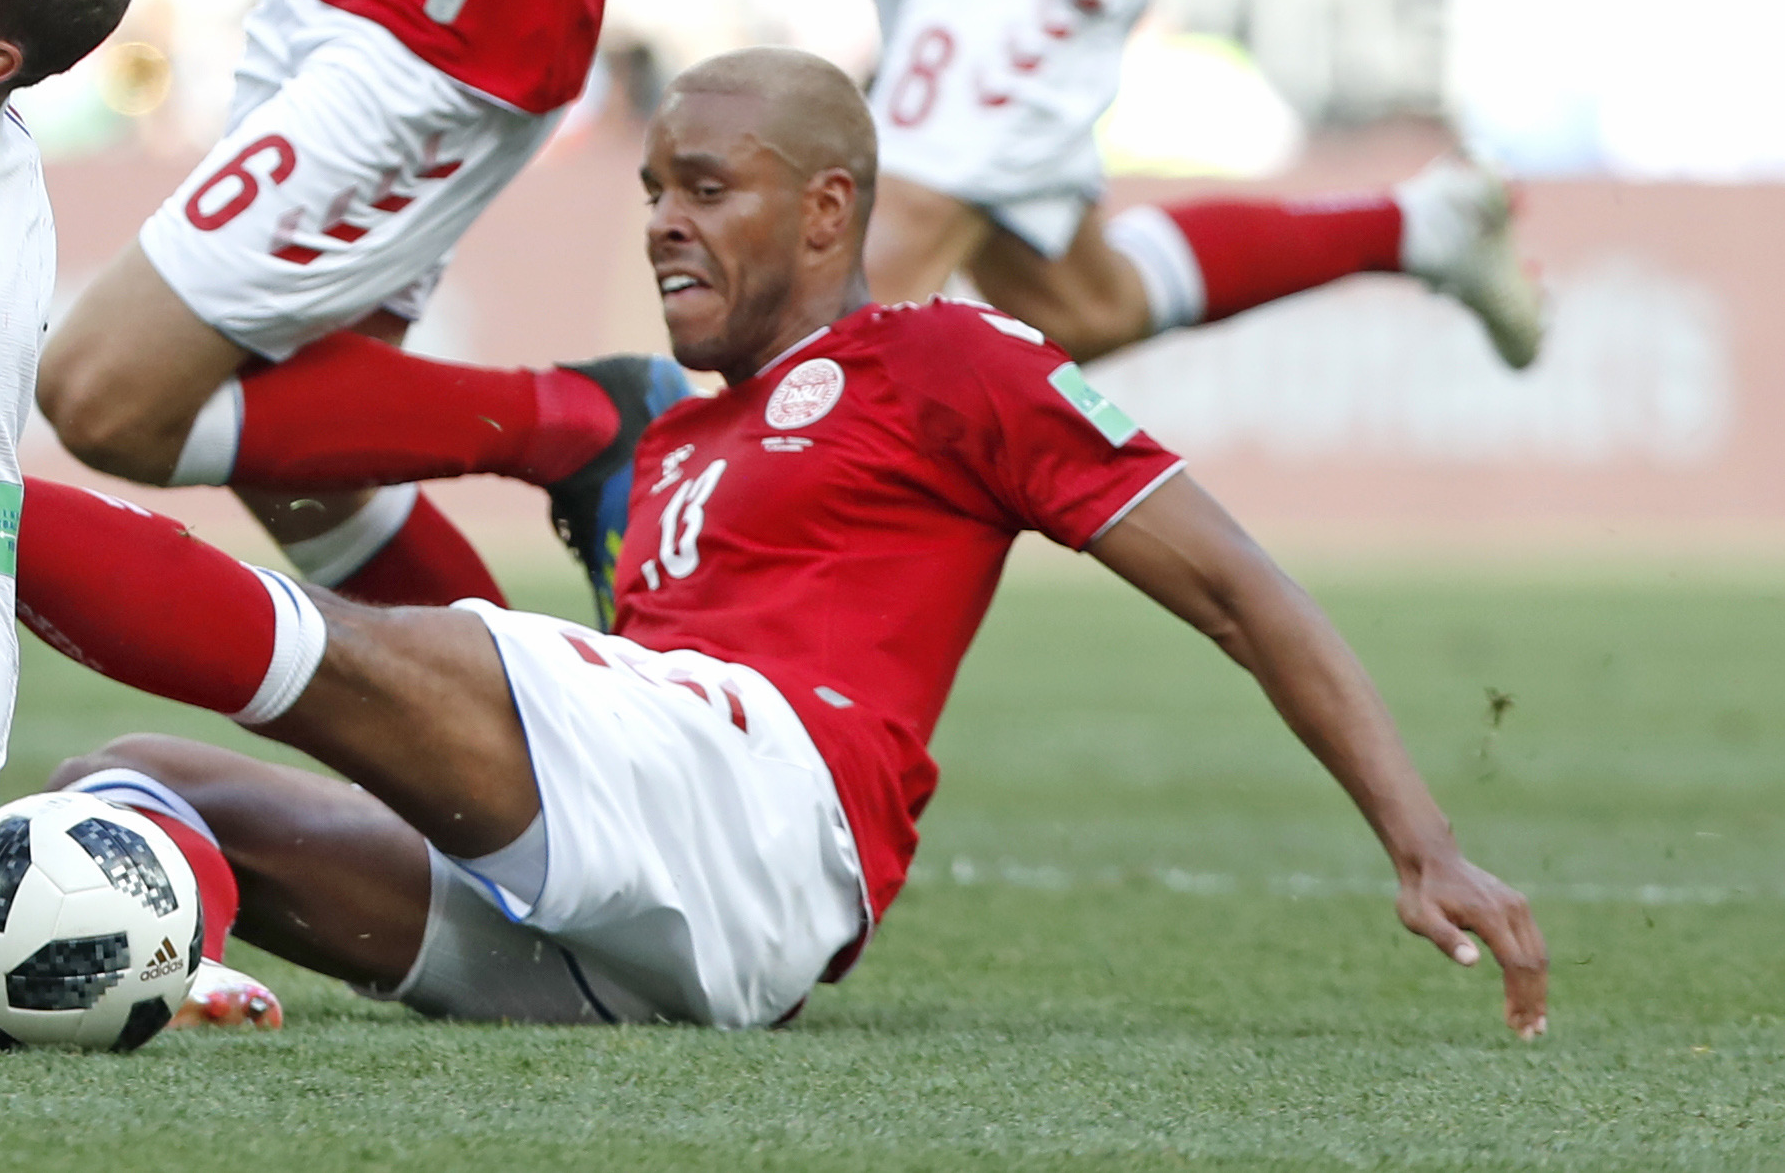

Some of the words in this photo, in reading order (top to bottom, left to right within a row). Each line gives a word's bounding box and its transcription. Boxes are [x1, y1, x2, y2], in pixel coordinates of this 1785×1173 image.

[889, 24, 955, 128] 8
[185, 134, 297, 232] 6
[140, 958, 184, 982] adidas
